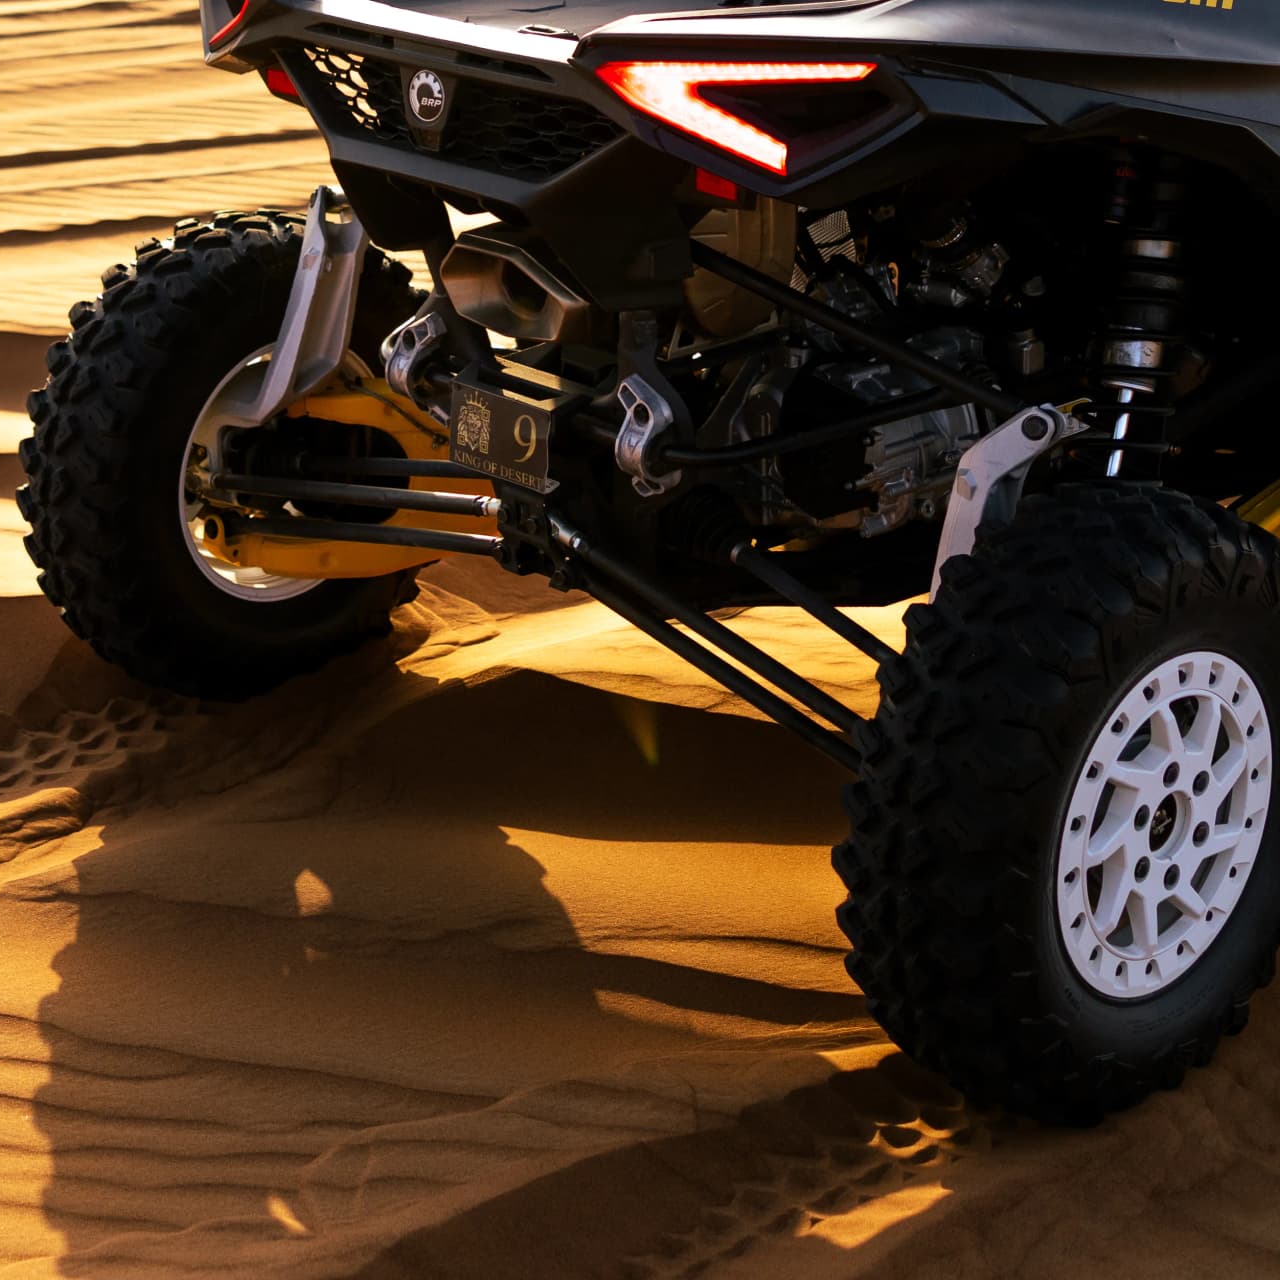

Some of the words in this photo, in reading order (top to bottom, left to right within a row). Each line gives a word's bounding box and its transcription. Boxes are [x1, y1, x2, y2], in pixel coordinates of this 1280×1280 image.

[421, 97, 442, 108] BRP
[512, 414, 537, 463] 9
[454, 449, 481, 469] KING
[482, 460, 498, 474] OF
[500, 465, 545, 490] DESERT
